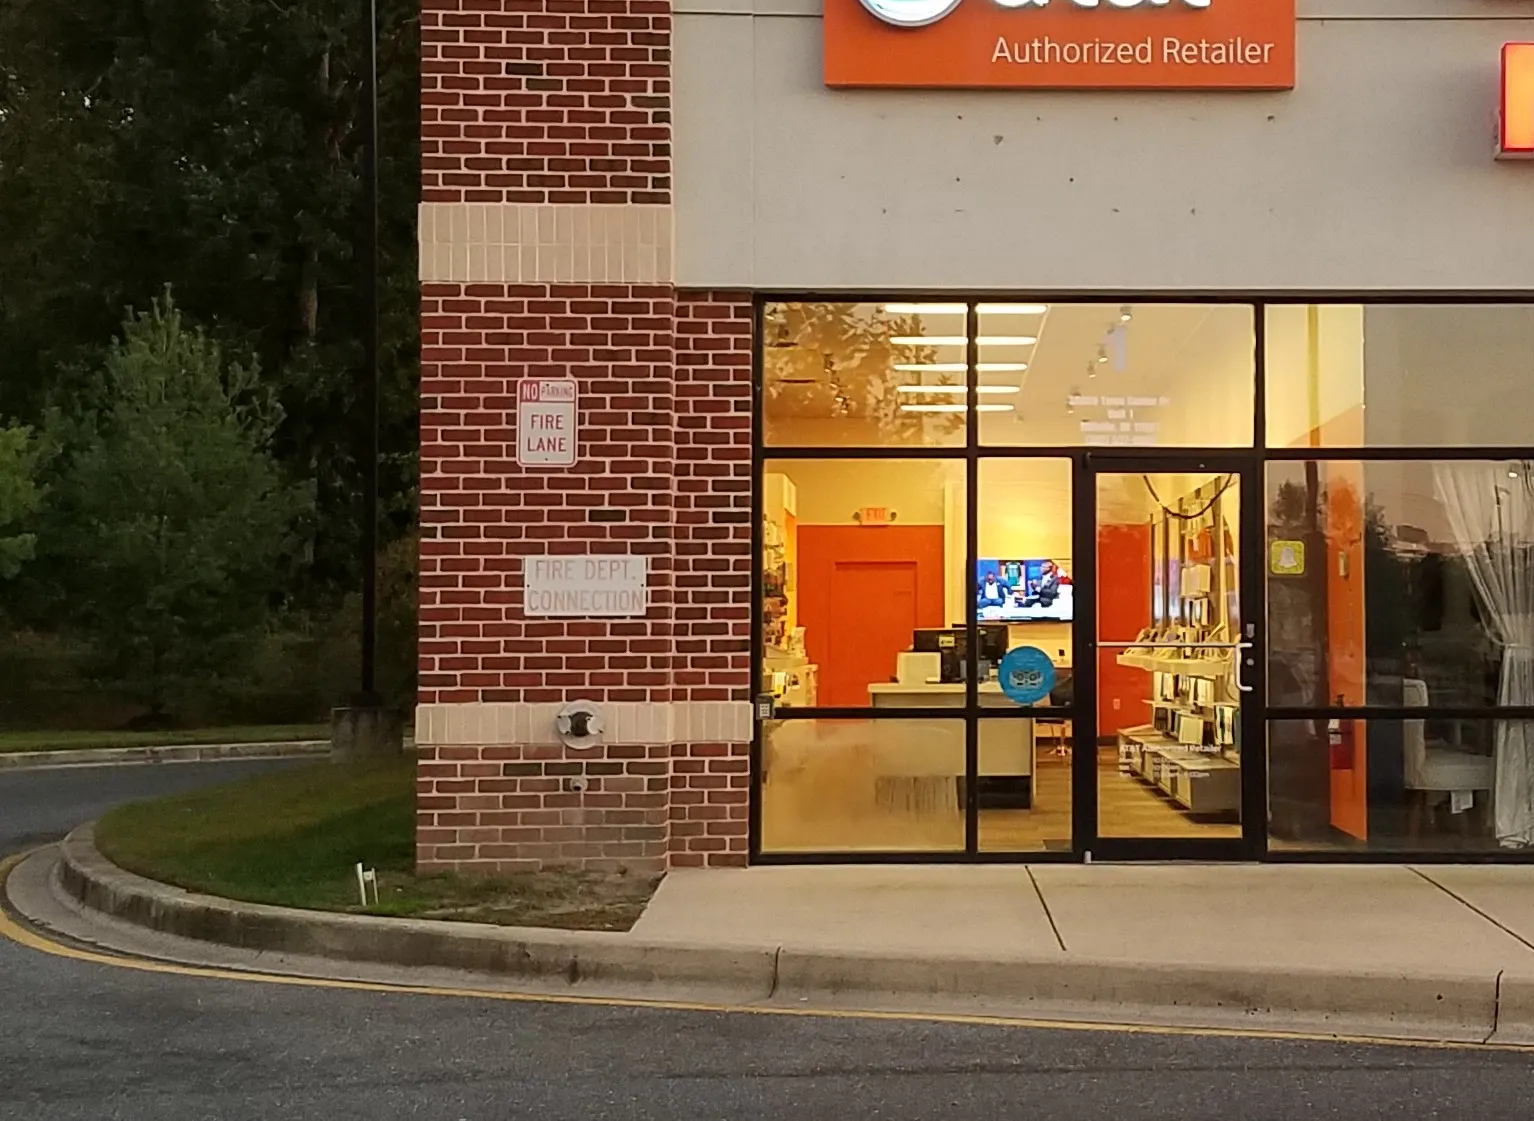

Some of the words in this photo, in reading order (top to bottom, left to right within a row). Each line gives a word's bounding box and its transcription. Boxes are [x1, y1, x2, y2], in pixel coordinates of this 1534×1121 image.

[991, 37, 1153, 64] Authorized
[1164, 37, 1274, 64] Retailer
[522, 383, 539, 400] NO
[541, 385, 574, 399] PARKING
[531, 414, 564, 430] FIRE
[527, 436, 567, 452] LANE
[535, 560, 573, 580] FIRE
[585, 559, 636, 580] DEPT.
[528, 589, 643, 613] CONNECTION
